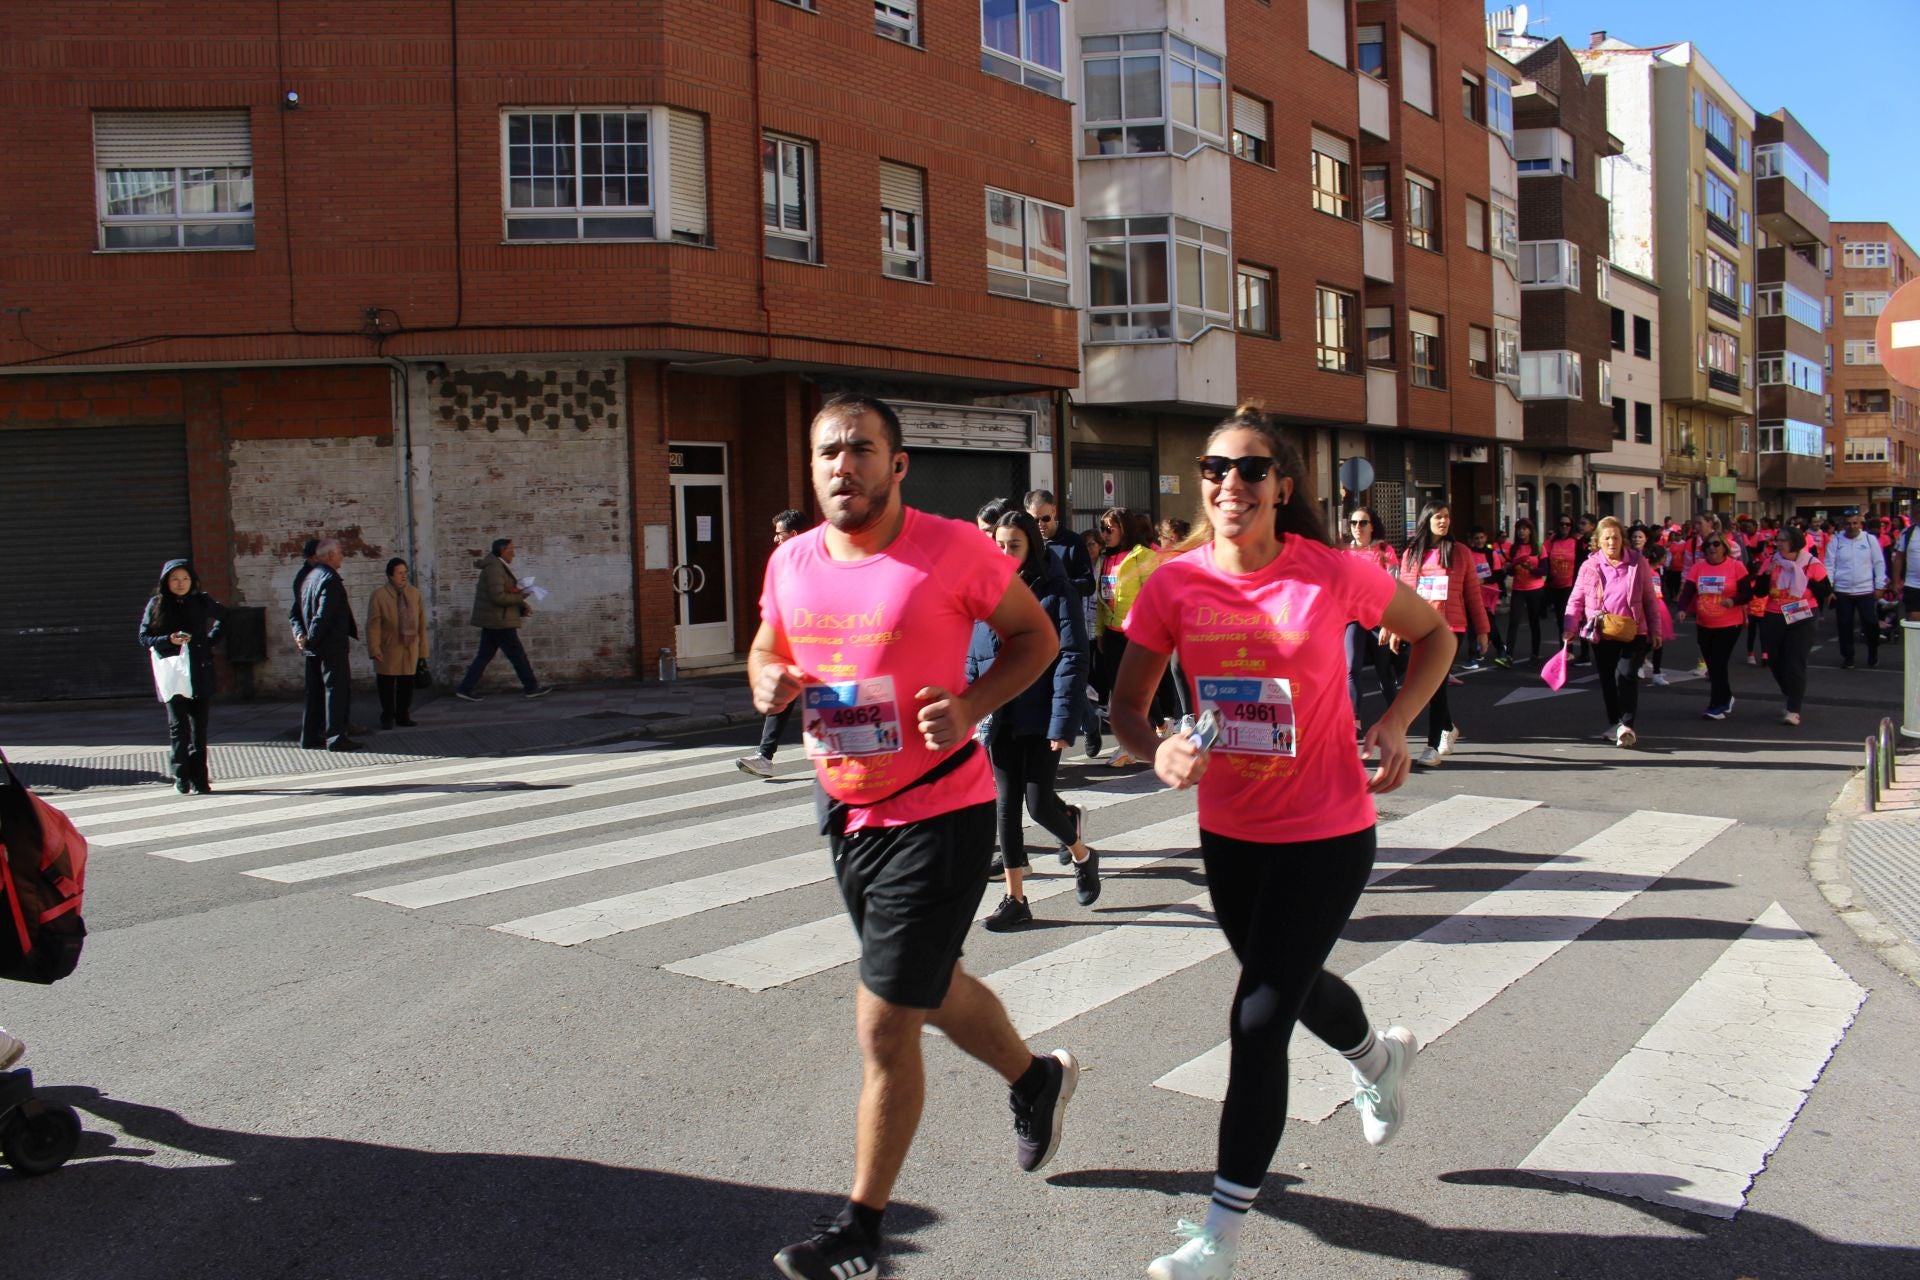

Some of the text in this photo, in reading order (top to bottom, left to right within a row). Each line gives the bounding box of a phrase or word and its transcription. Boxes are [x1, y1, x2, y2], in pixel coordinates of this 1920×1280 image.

[670, 454, 683, 466] 20
[832, 705, 881, 726] 4962
[1235, 703, 1276, 722] 4961
